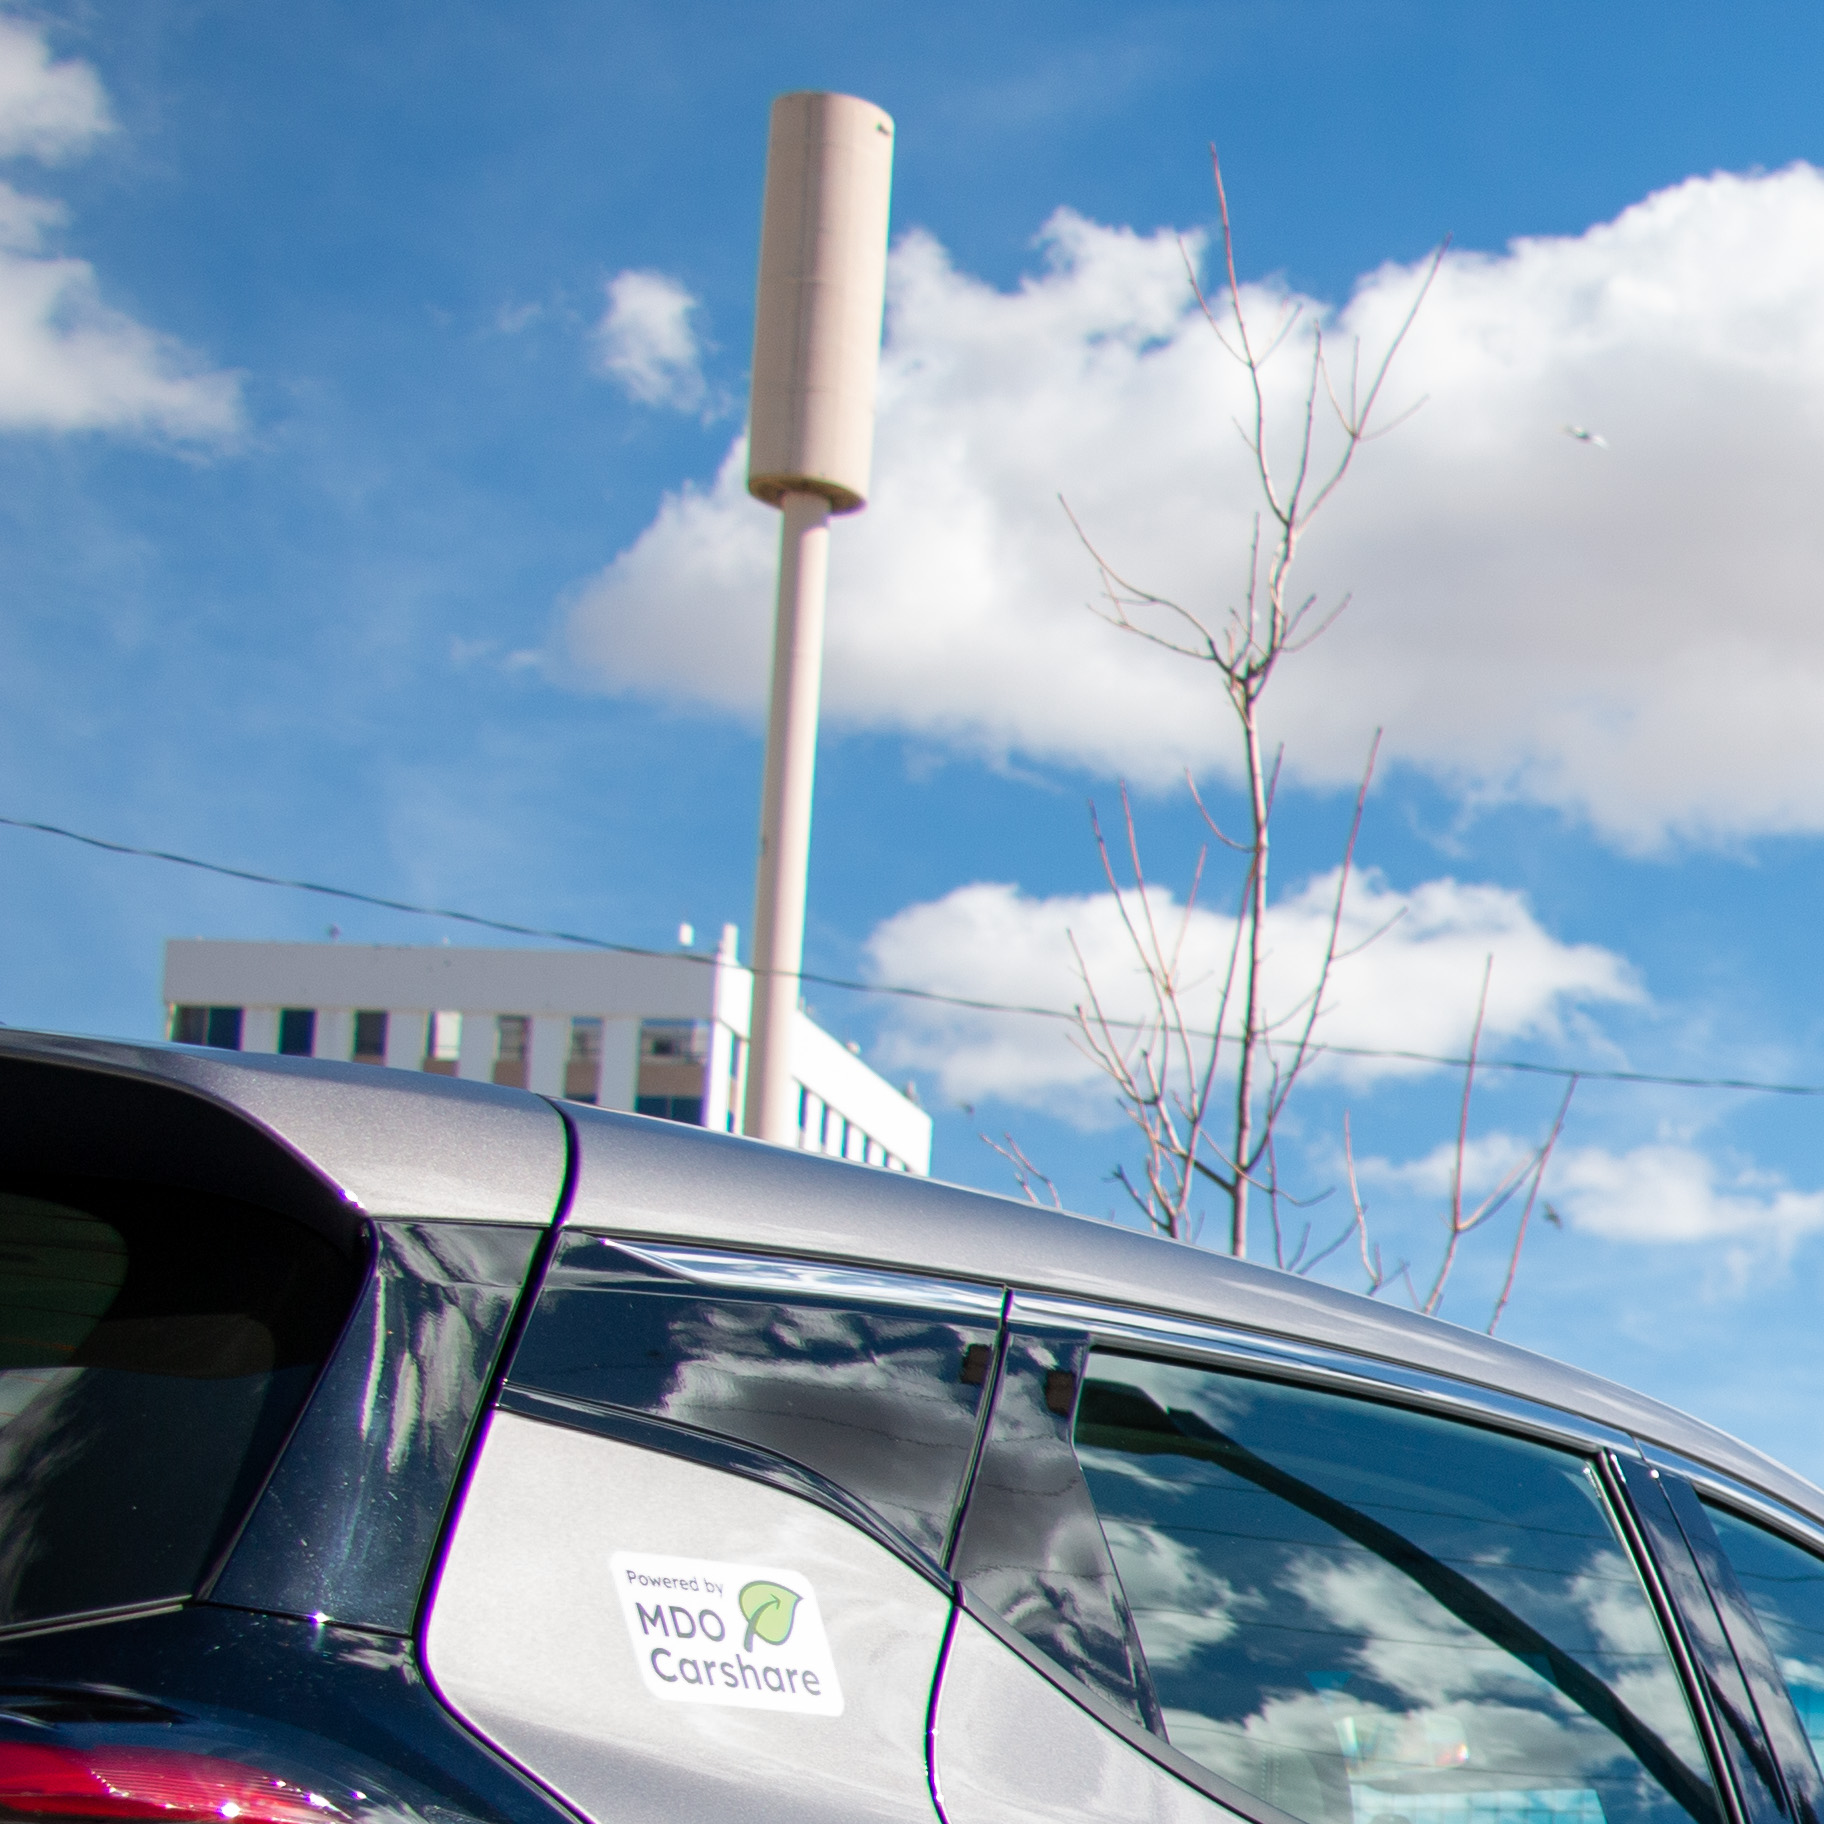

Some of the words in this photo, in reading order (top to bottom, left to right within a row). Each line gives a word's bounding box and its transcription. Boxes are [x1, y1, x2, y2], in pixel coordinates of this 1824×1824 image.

[625, 1569, 700, 1592] Powered
[704, 1577, 724, 1598] by
[635, 1602, 726, 1642] MDO
[651, 1647, 822, 1696] Carshare
